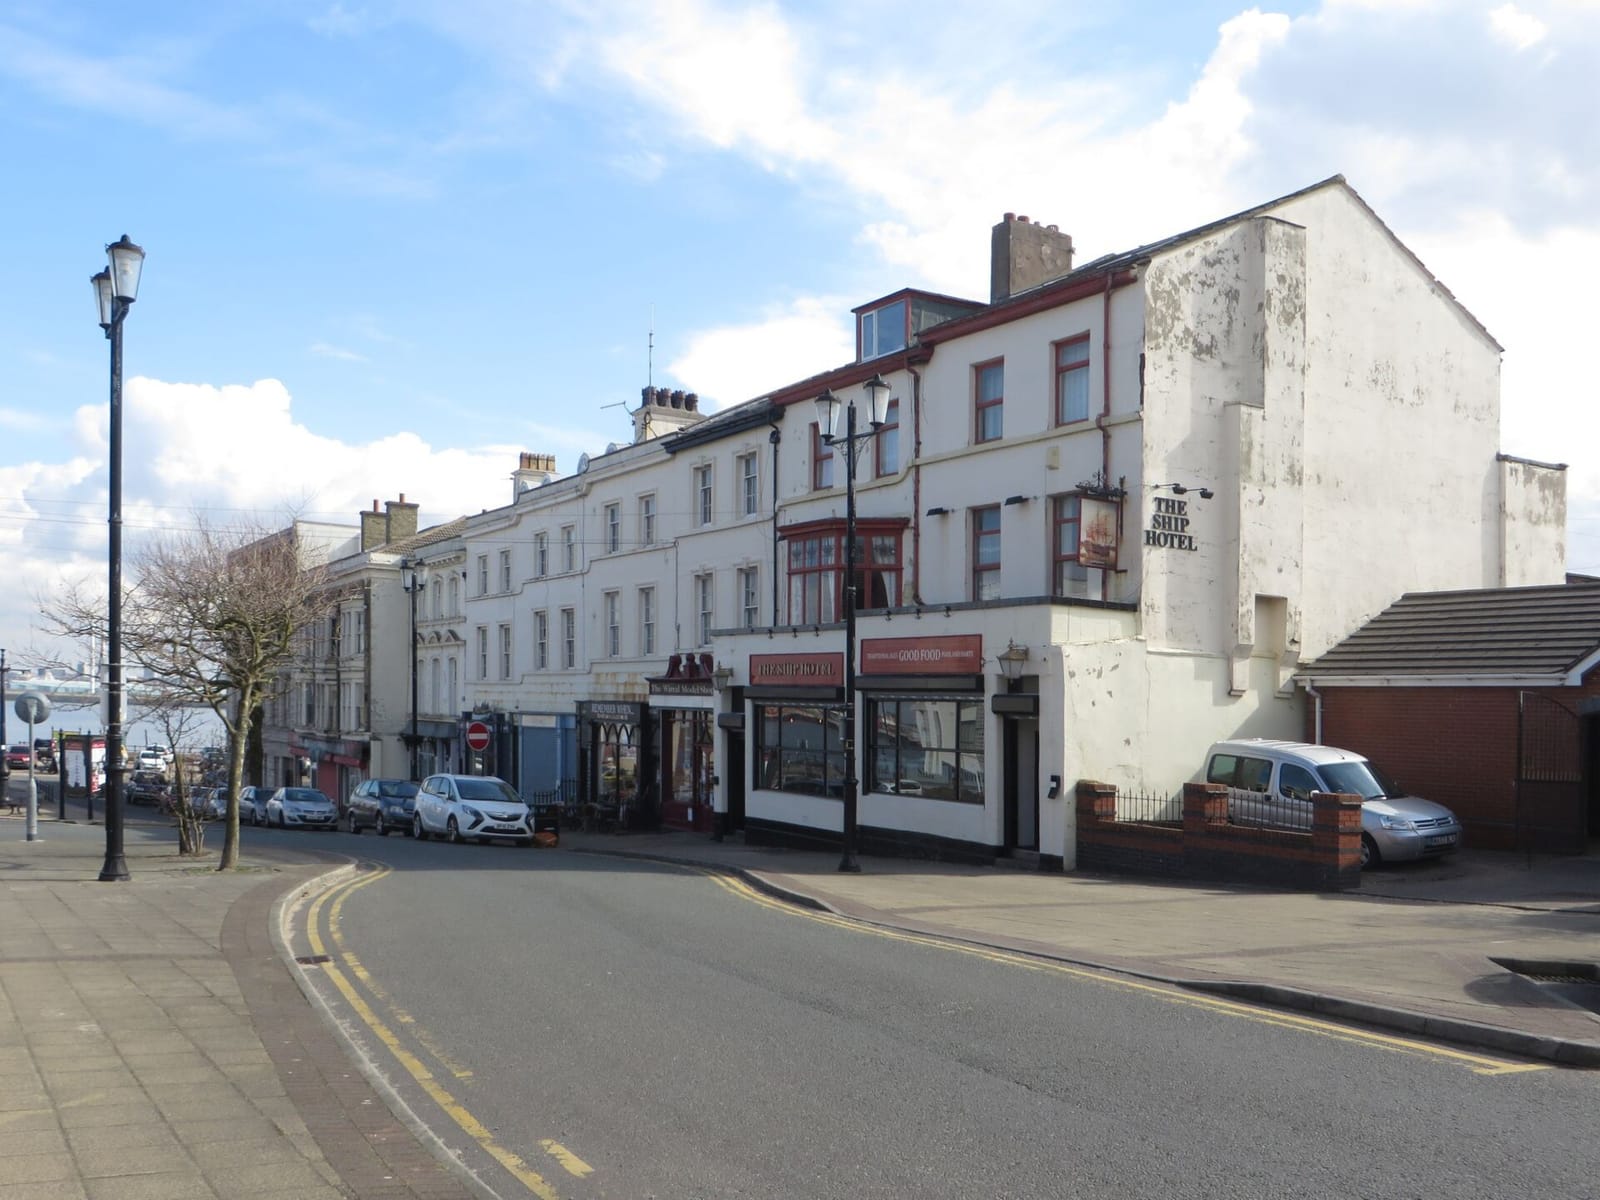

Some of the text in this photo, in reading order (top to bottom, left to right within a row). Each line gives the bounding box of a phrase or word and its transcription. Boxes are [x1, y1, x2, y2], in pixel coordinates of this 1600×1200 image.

[1154, 497, 1188, 516] THE
[1152, 514, 1190, 533] SHIP
[1144, 530, 1198, 551] HOTEL
[898, 649, 920, 662] GOOD
[920, 648, 941, 661] FOOD
[757, 662, 836, 676] THE SHIP HOTEL
[651, 683, 662, 692] The
